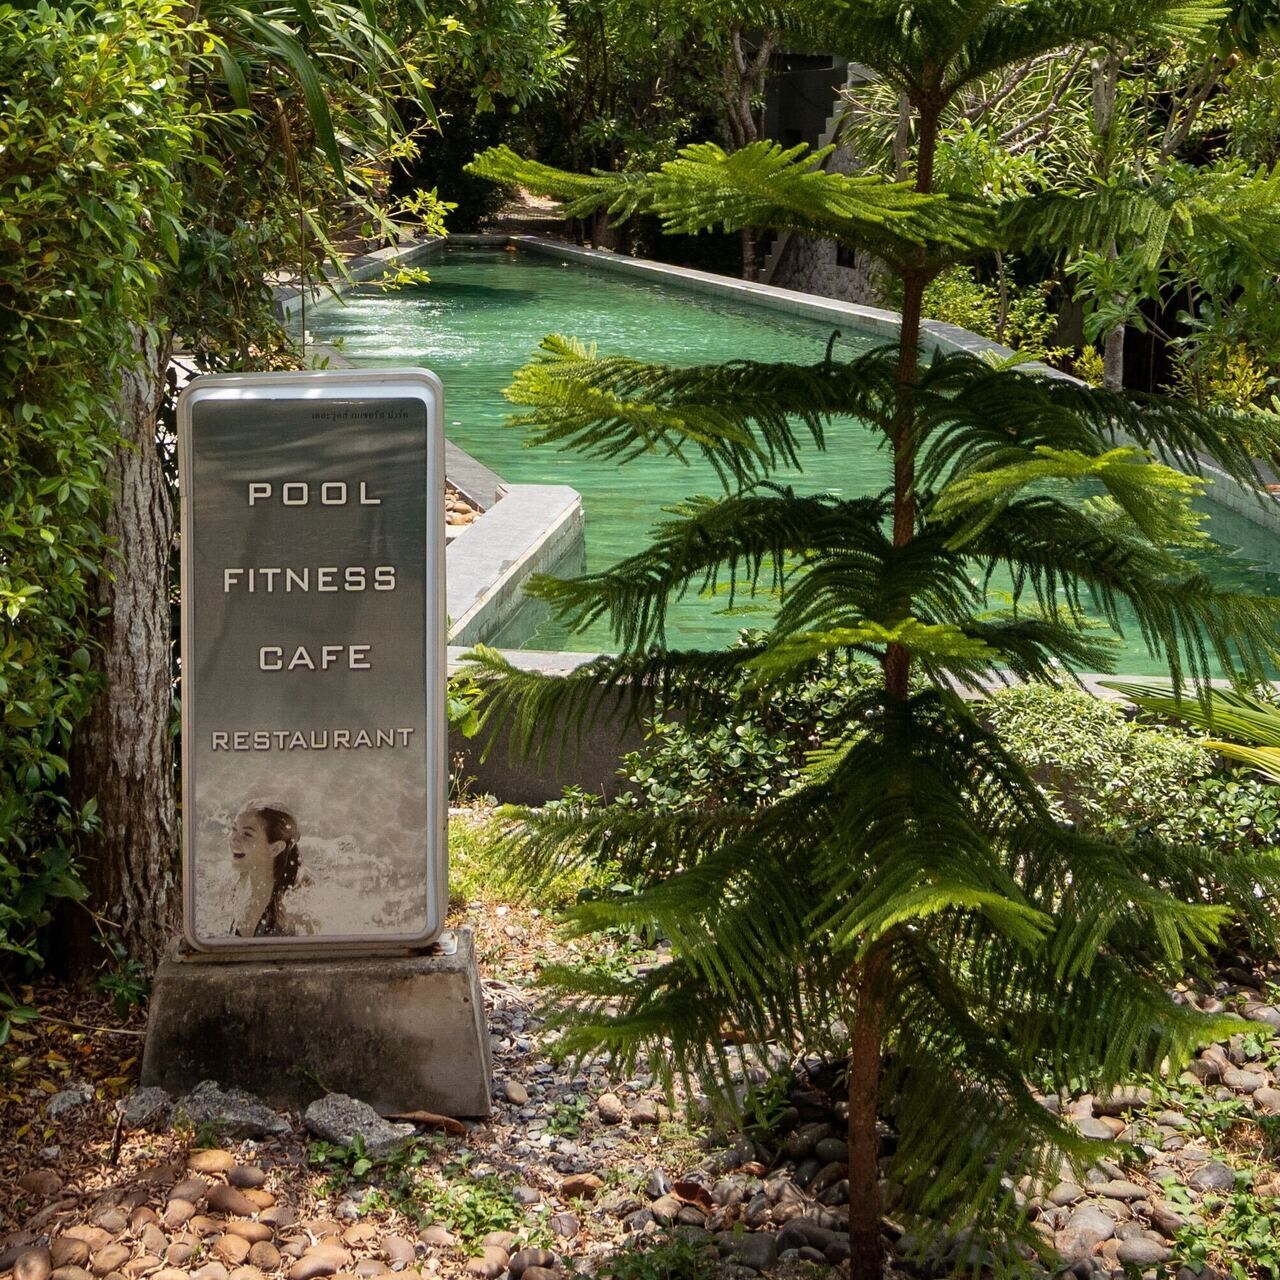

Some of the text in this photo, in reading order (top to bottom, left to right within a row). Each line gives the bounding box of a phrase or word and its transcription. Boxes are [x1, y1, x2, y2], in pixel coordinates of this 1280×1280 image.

[248, 481, 382, 506] POOL
[223, 566, 396, 593] FITNESS
[259, 644, 372, 671] CAFE
[211, 727, 415, 751] RESTAURANT
